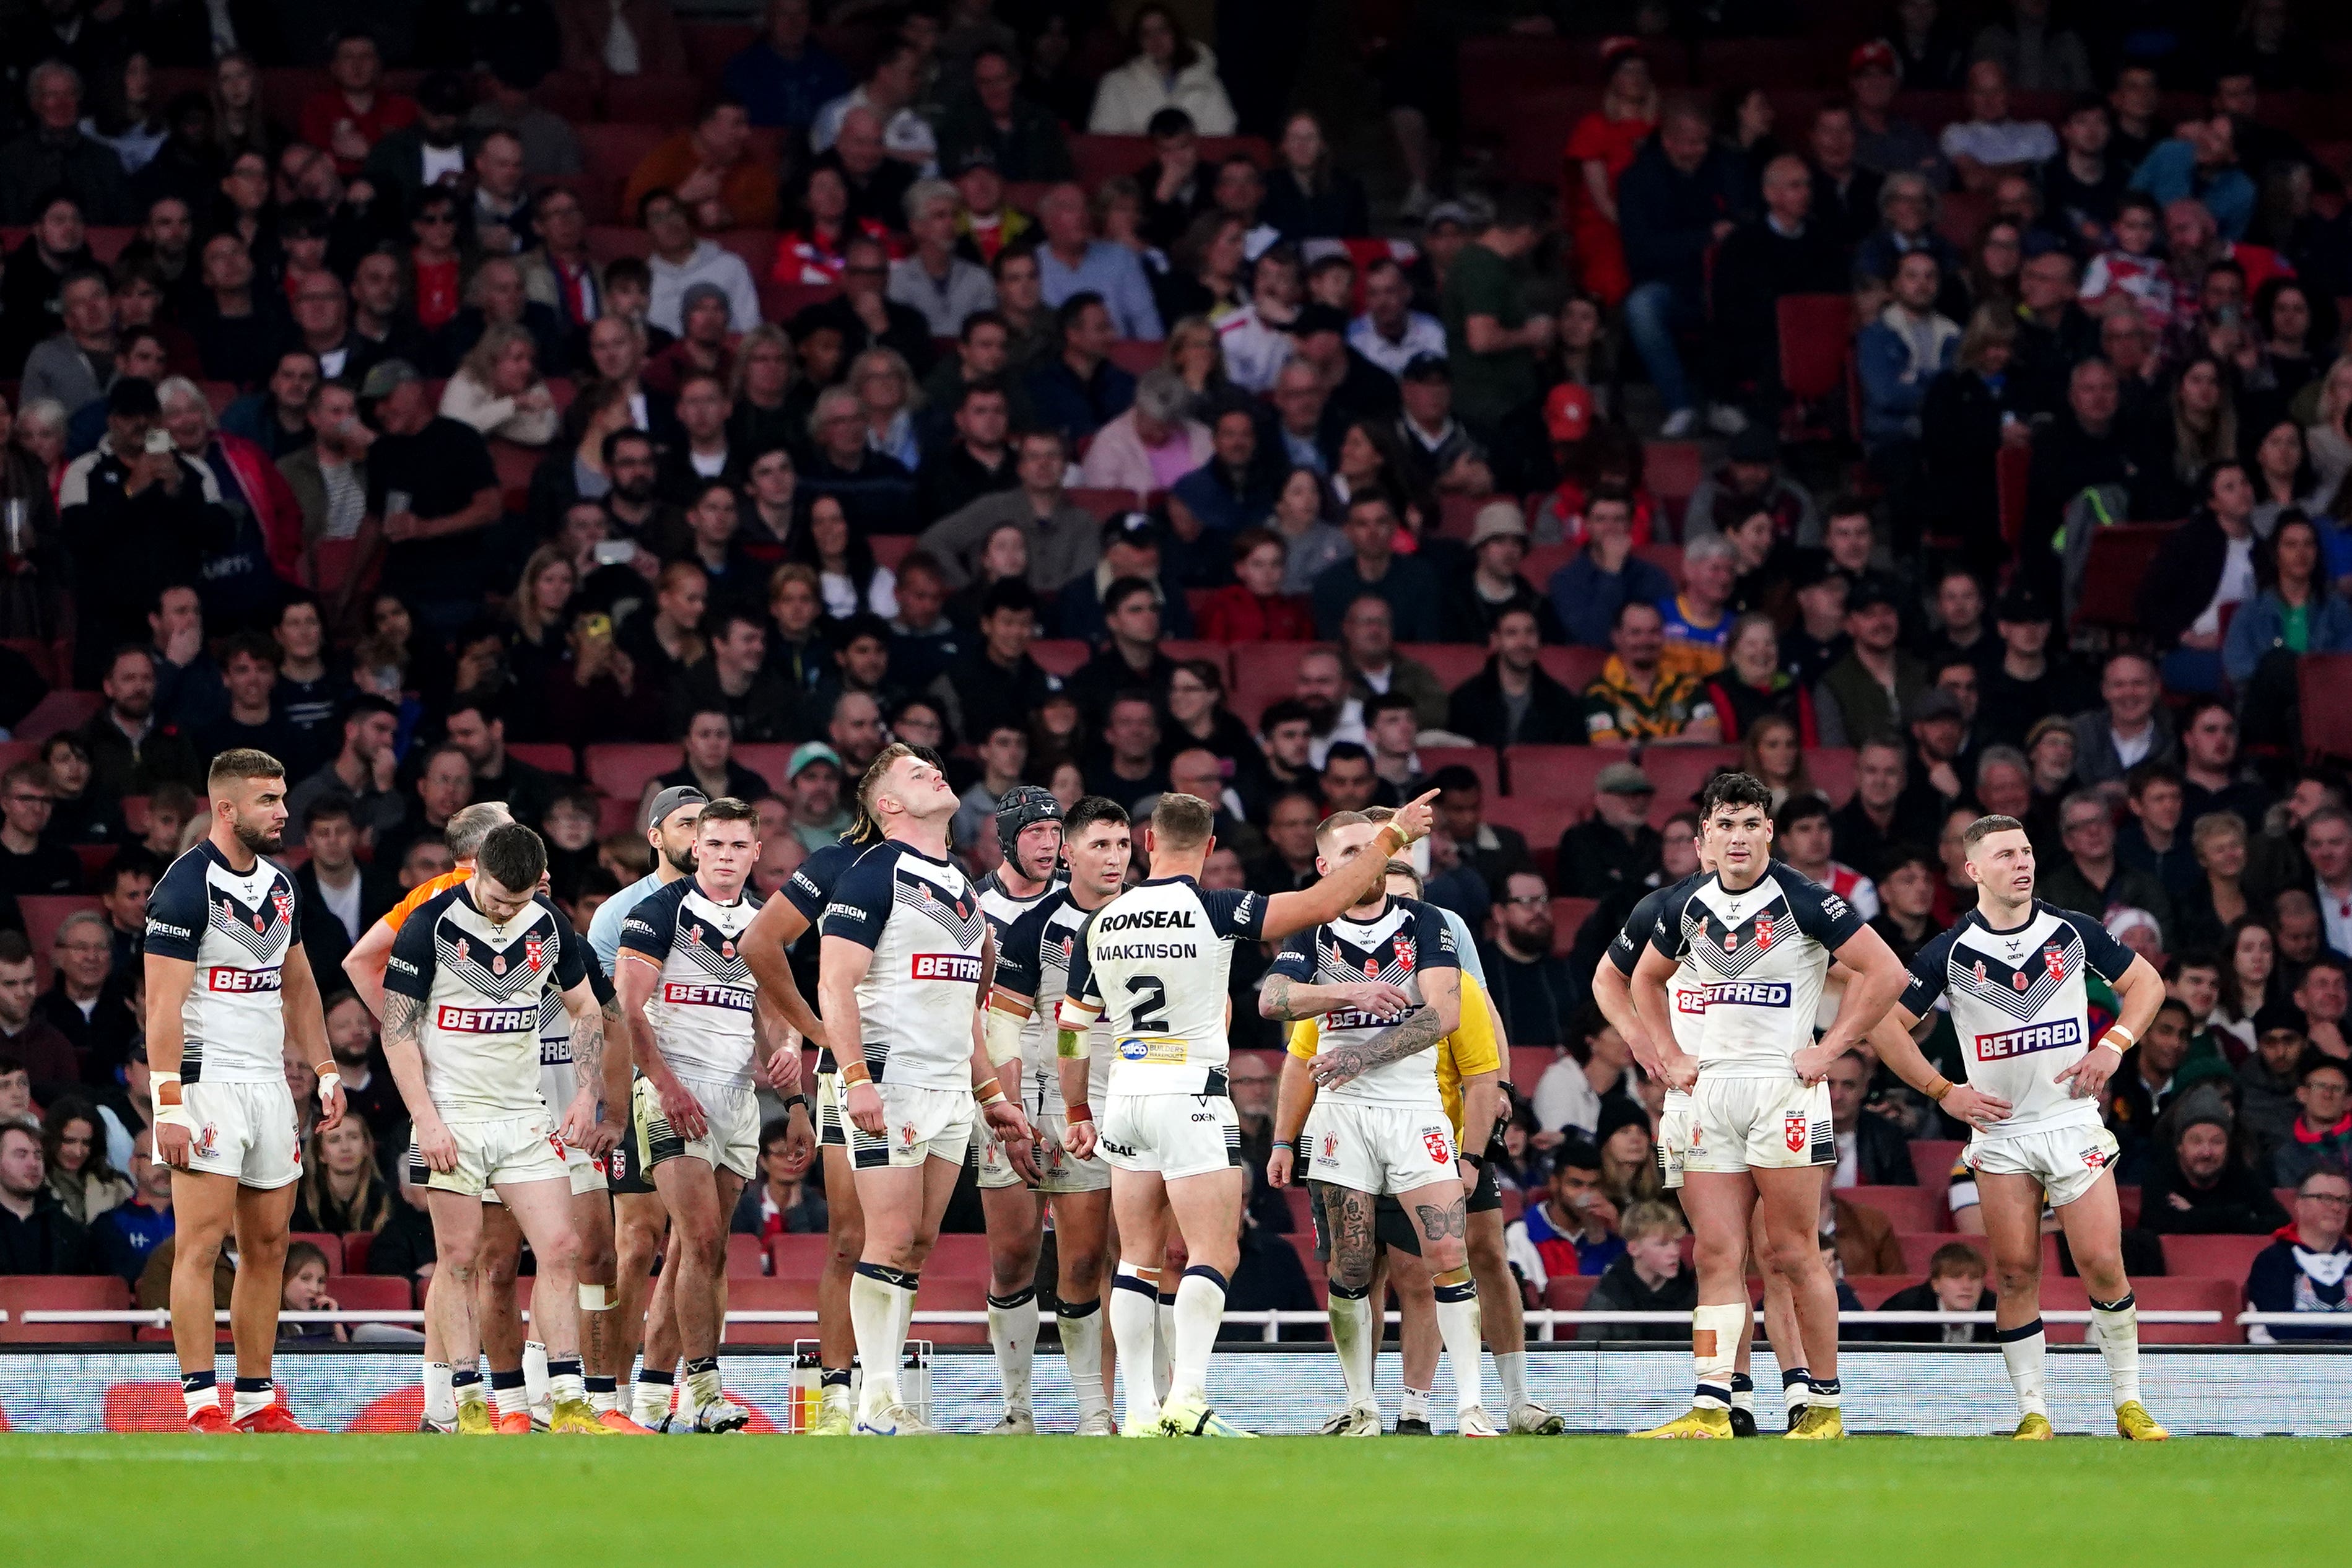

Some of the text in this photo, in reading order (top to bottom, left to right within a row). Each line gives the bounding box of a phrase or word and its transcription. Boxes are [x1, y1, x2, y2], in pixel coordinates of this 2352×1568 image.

[830, 903, 867, 921] REIGN
[155, 923, 191, 938] REIGN
[1100, 911, 1196, 933] RONSEAL
[1097, 944, 1196, 960] MAKINSON
[2007, 952, 2024, 960] OXEN
[917, 957, 982, 980] BETFR
[1704, 983, 1787, 1004] ETFRED
[1125, 975, 1169, 1033] 2
[1980, 1022, 2078, 1057] BETFRED
[1149, 1045, 1184, 1053] BUILDERS
[1191, 1113, 1216, 1122] OXEN
